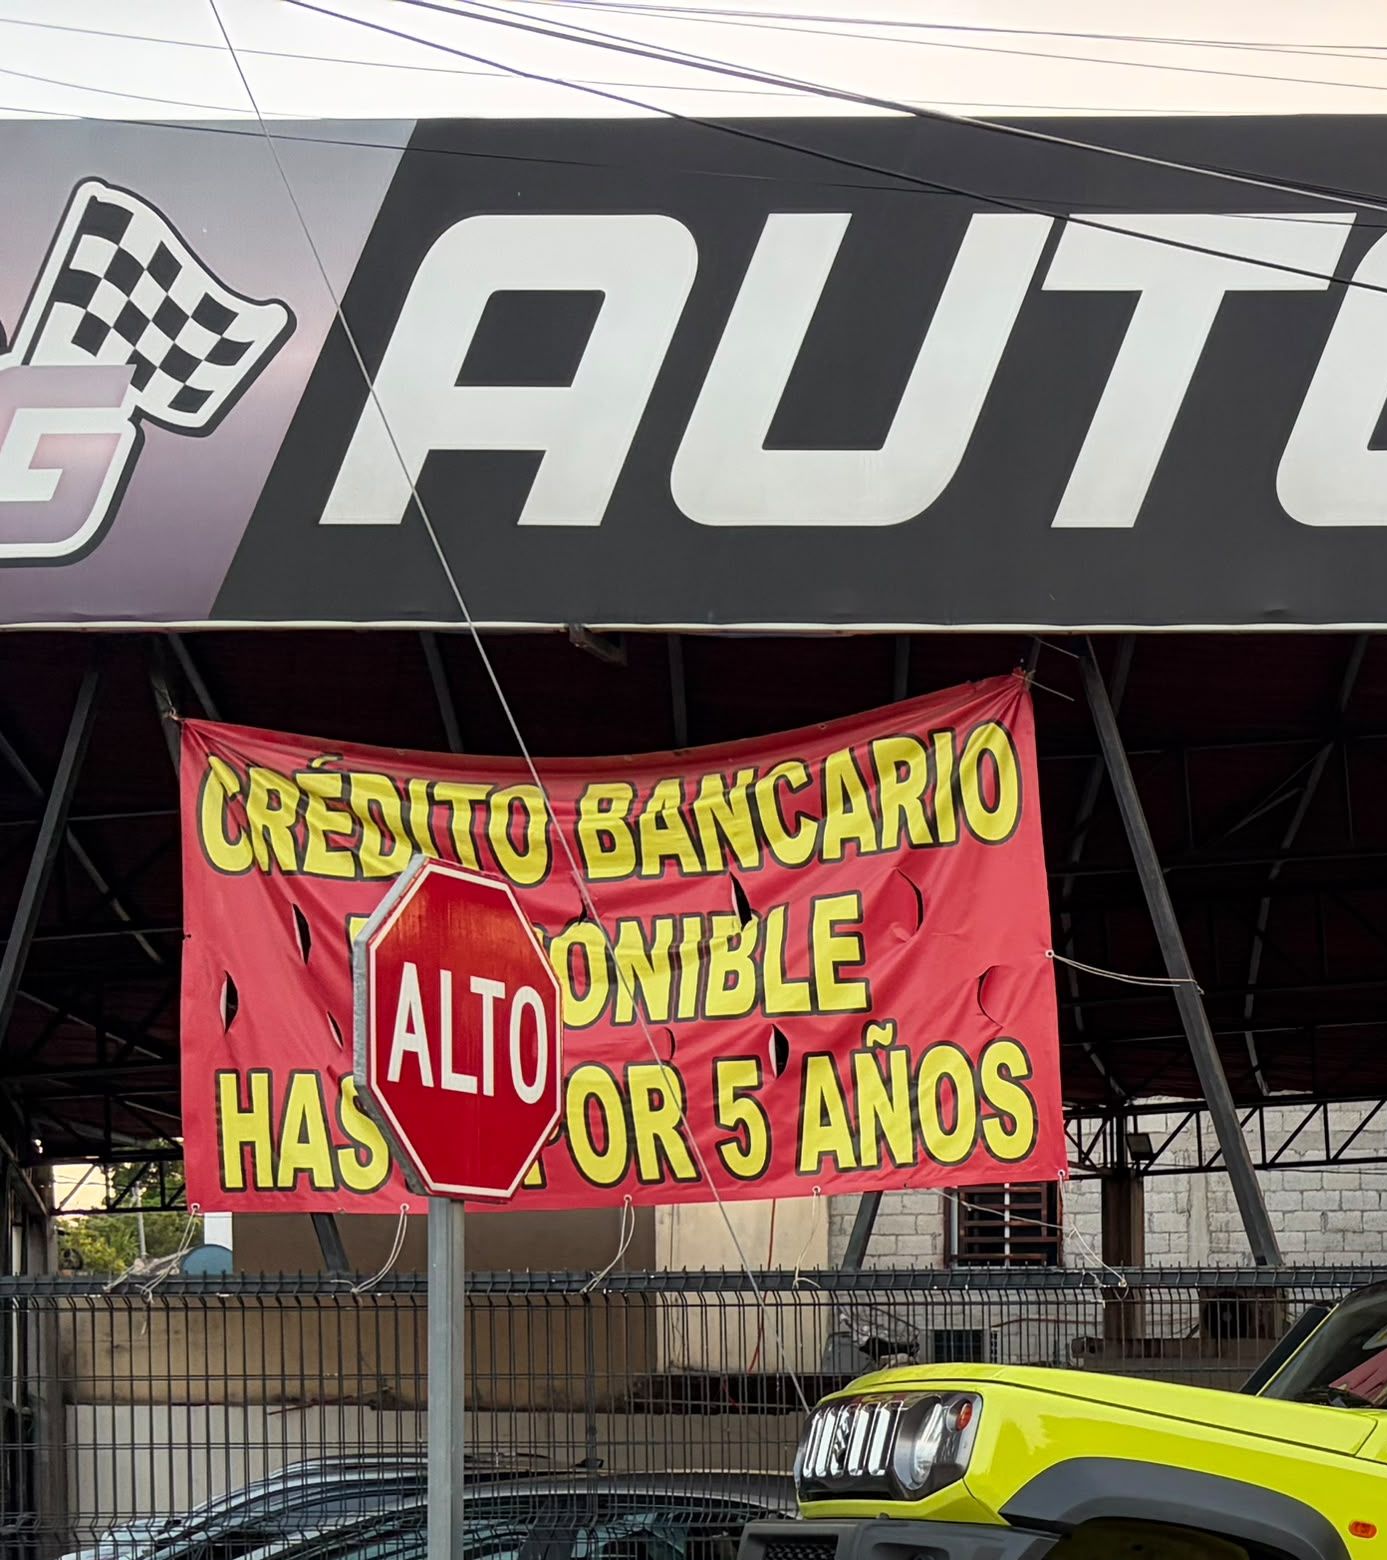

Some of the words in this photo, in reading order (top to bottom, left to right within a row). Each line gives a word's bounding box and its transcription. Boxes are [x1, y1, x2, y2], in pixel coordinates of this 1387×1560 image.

[199, 755, 552, 885] CRÉDITO
[574, 721, 1022, 882] BANCARIO
[347, 891, 871, 1030] ONIBLE
[387, 962, 548, 1104] ALTO
[216, 1068, 395, 1193] HAS
[522, 1062, 700, 1191] OR
[713, 1056, 771, 1181] 5
[797, 1019, 1040, 1177] AÑOS
